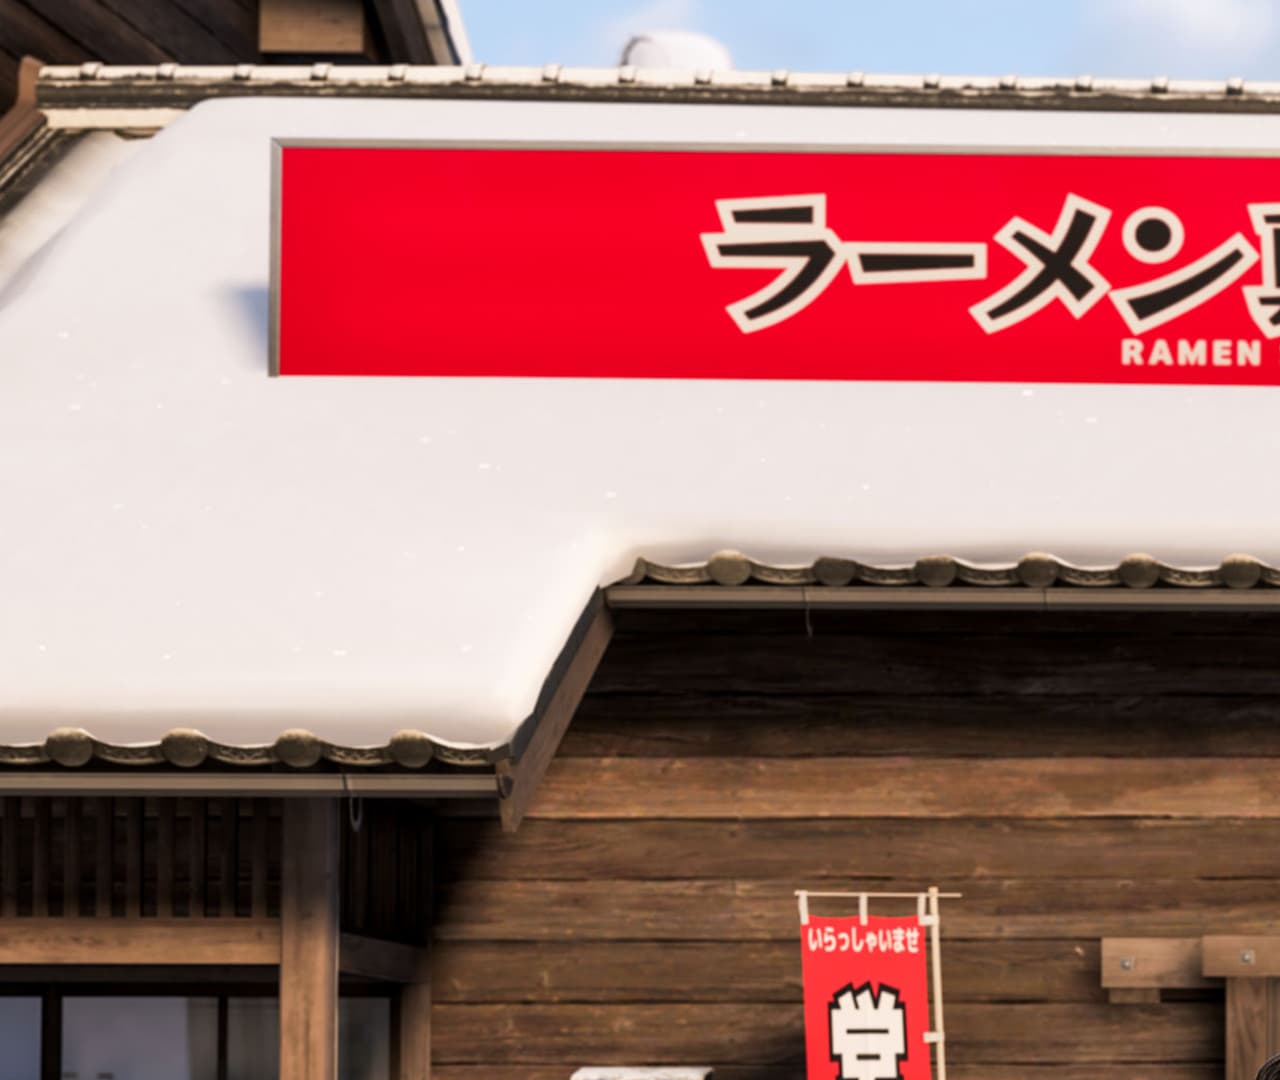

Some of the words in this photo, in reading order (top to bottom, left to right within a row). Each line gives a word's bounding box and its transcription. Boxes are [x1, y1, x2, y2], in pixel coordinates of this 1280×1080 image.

[1120, 338, 1262, 366] RAMEN
[807, 925, 920, 953] いらっしゃいませ
